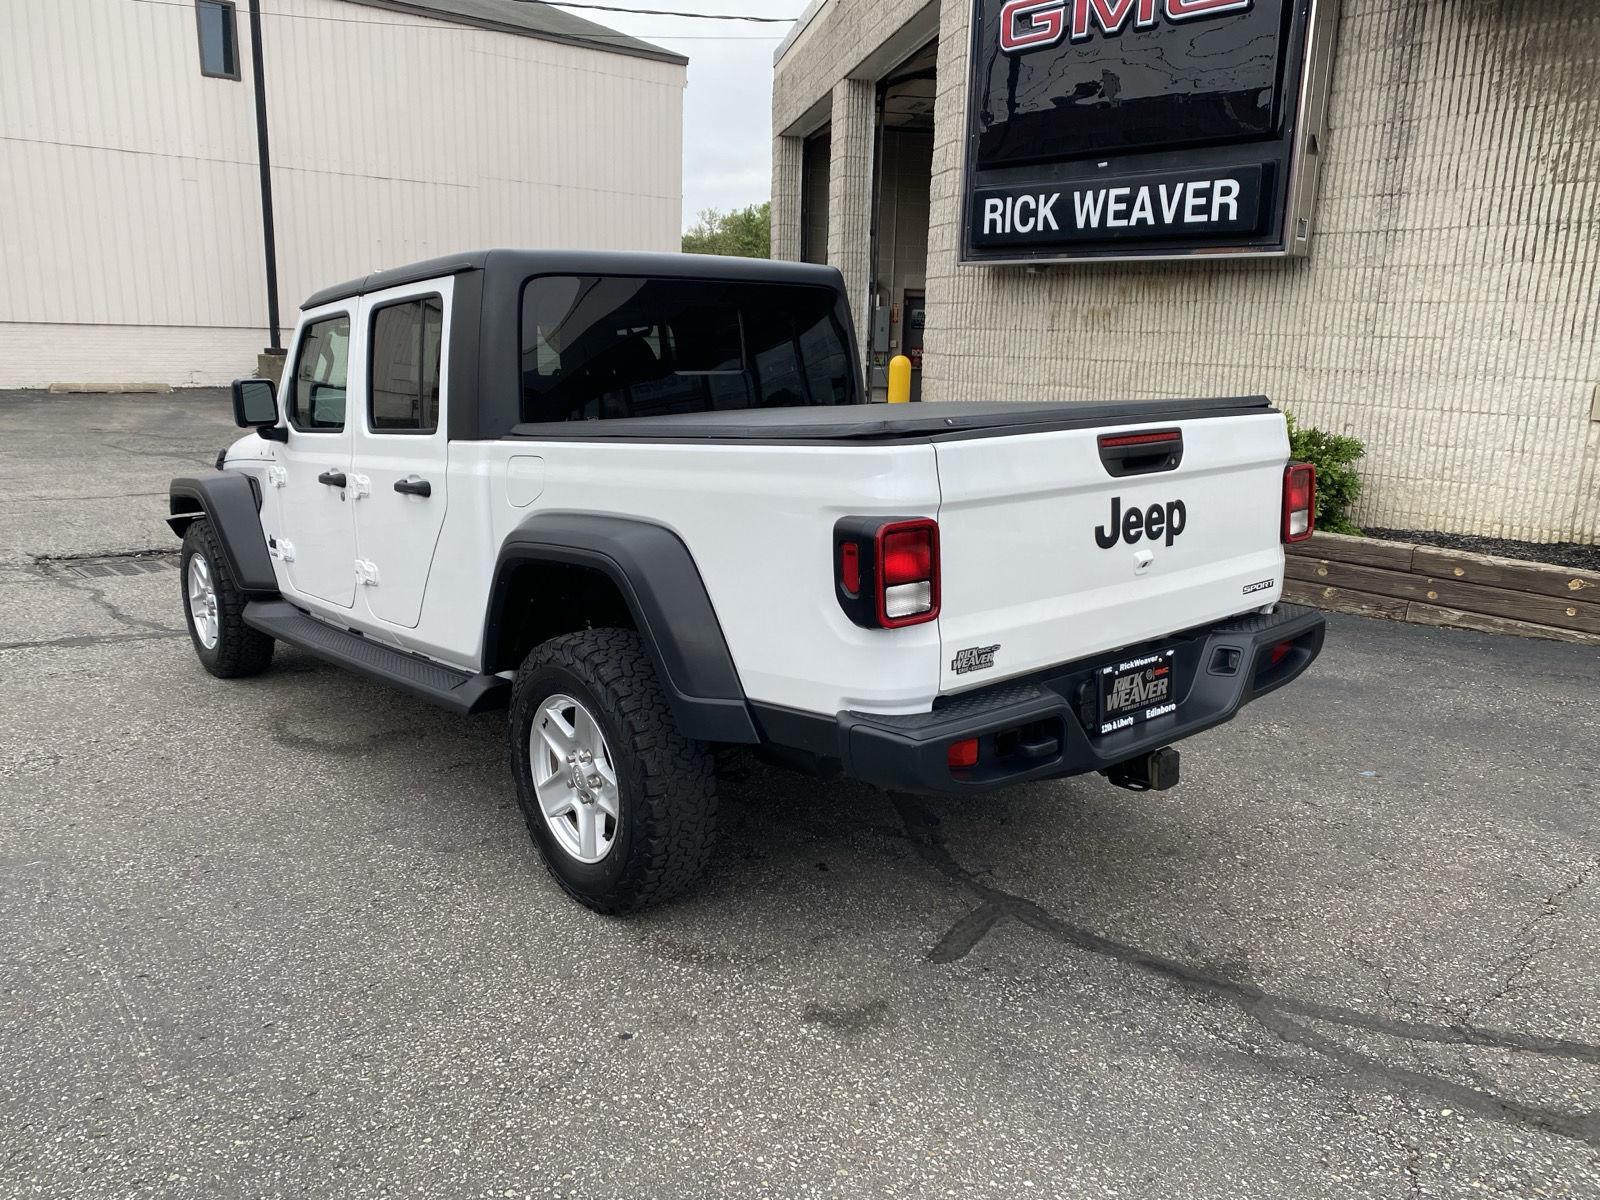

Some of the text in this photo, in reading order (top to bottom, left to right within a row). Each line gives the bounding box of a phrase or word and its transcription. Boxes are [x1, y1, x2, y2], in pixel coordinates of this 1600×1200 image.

[983, 178, 1241, 235] RICK WEAVER
[1094, 496, 1187, 550] Jeep
[1243, 579, 1274, 596] SPORT
[953, 653, 994, 670] WEAVER
[957, 648, 978, 660] RICK
[1112, 671, 1145, 694] RICK
[1106, 678, 1169, 712] WEAVER
[1146, 703, 1176, 719] Edinboro
[1117, 716, 1134, 729] Liberty
